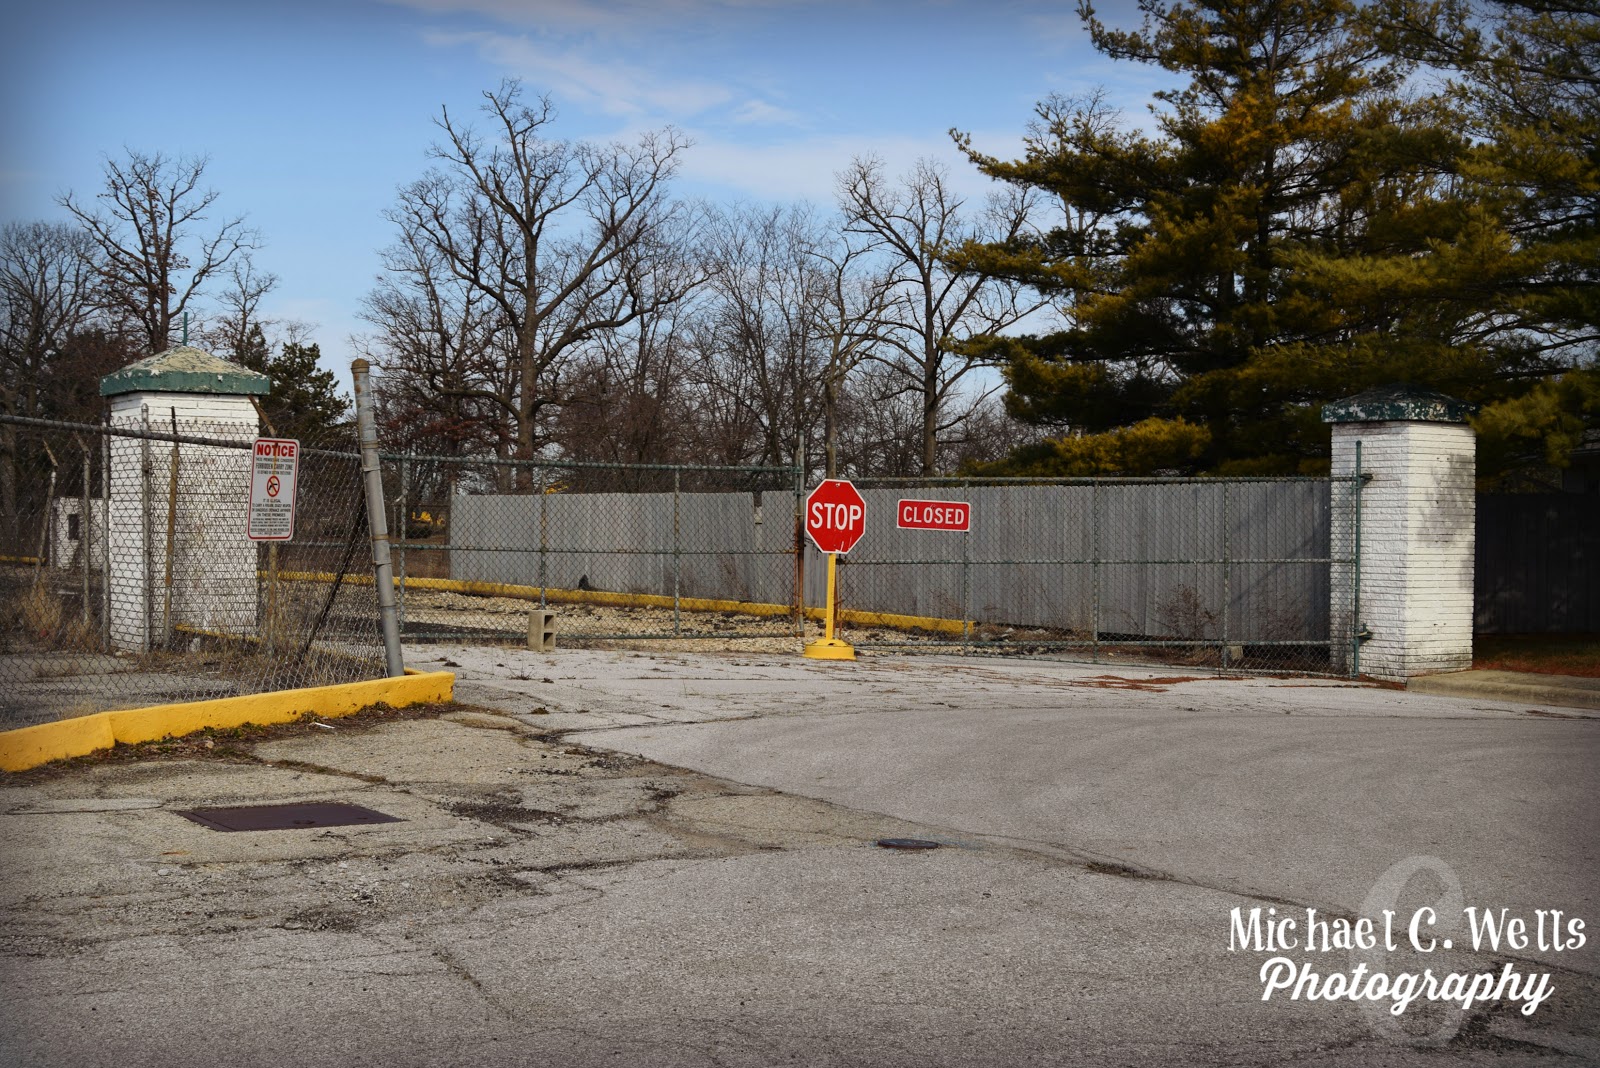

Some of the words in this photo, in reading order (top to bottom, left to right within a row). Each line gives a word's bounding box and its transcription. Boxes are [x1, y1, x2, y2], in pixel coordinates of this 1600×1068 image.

[256, 444, 295, 457] NOTICE
[810, 502, 862, 531] STOP
[903, 506, 965, 525] CLOSED
